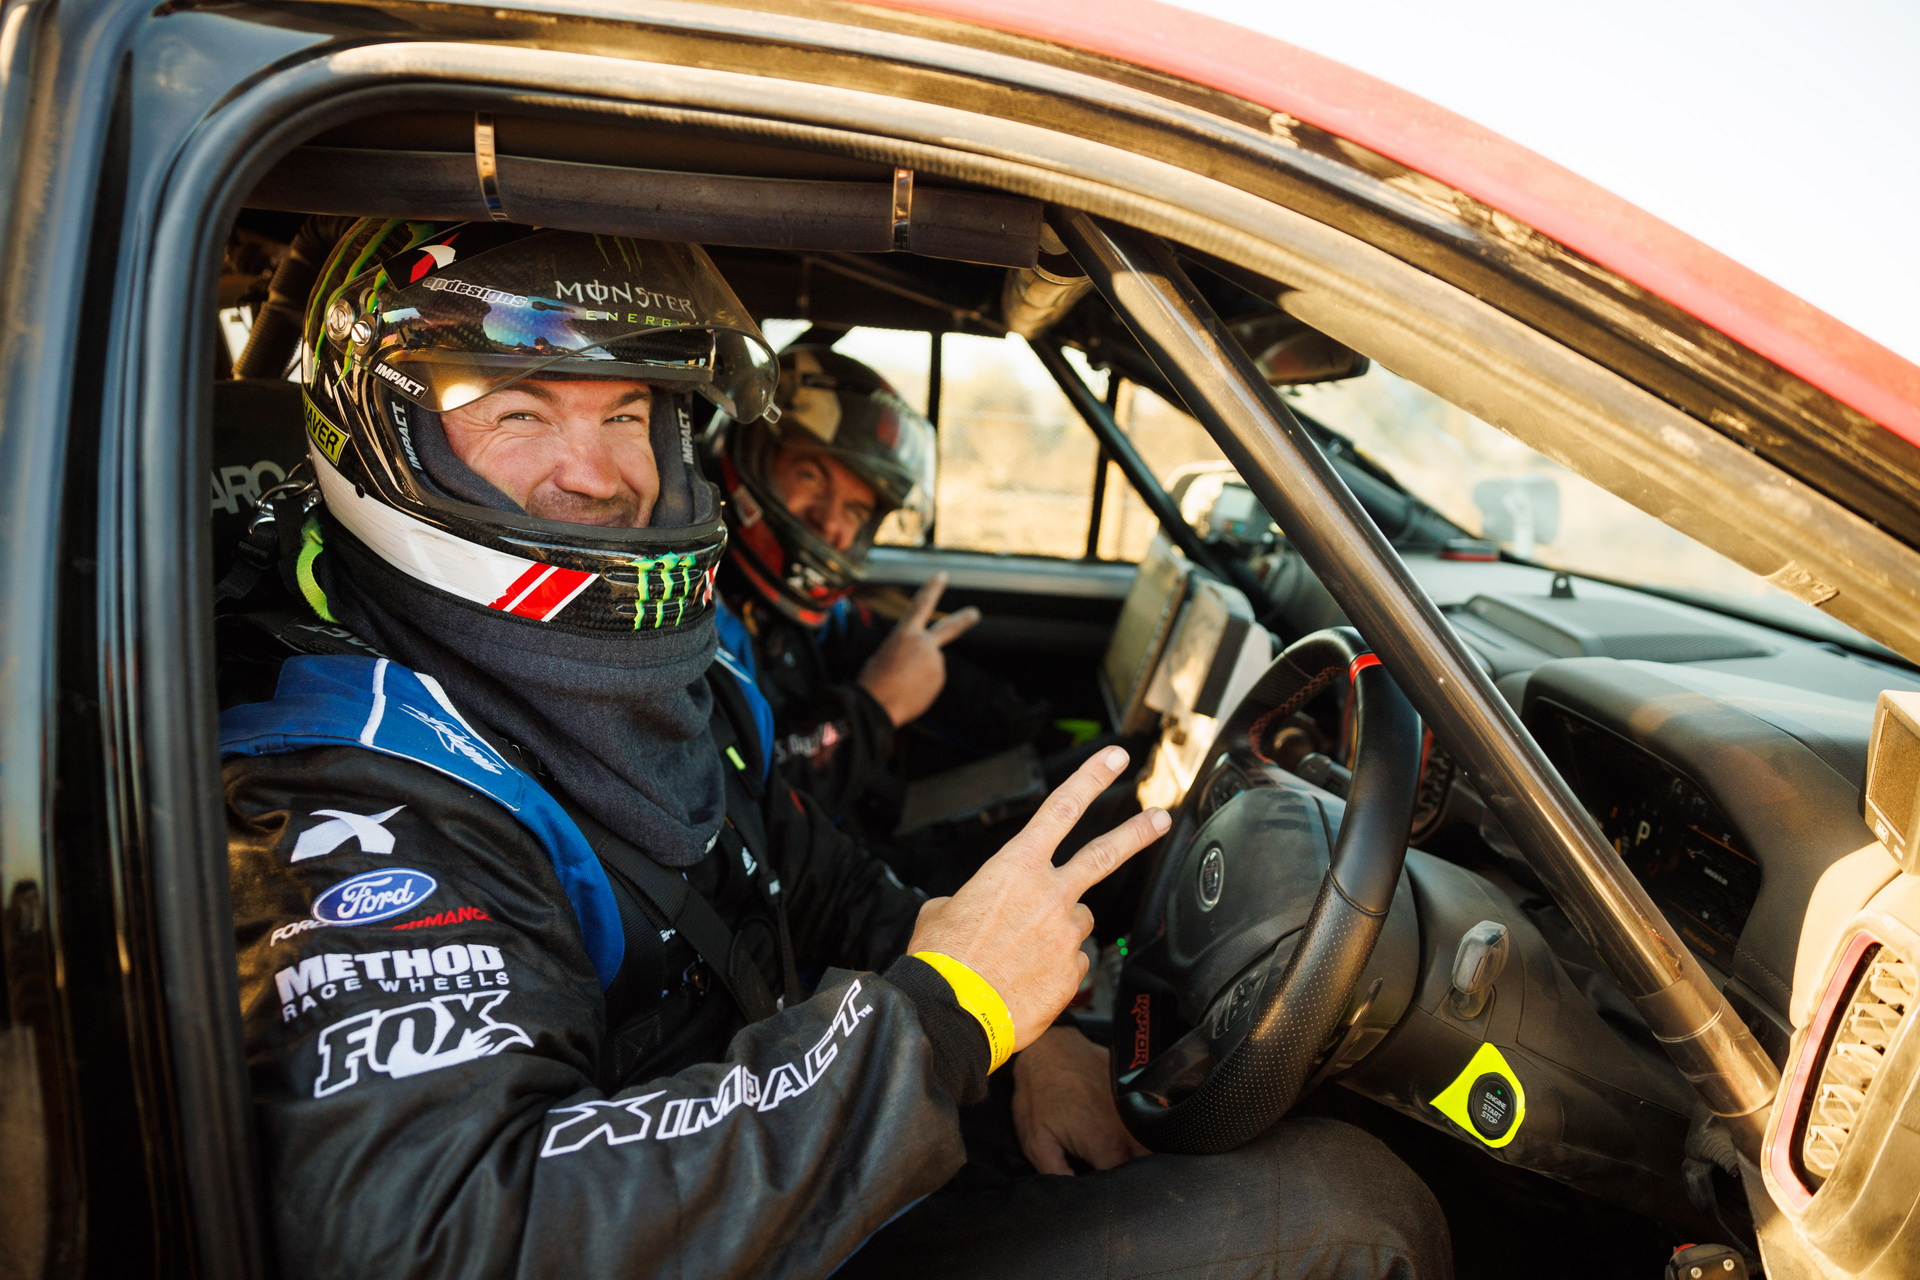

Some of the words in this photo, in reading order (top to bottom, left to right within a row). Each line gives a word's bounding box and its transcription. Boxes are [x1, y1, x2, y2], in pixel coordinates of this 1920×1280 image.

[422, 276, 529, 308] apdesigns
[554, 279, 697, 319] MONSTER
[374, 362, 426, 397] IMPACT
[391, 401, 424, 471] IMPACT
[677, 407, 695, 465] IMPACT
[1635, 820, 1651, 846] P
[336, 876, 415, 919] Ford
[274, 943, 505, 1004] METHOD
[281, 976, 363, 1023] RACE
[378, 970, 511, 993] WHEELS
[313, 989, 535, 1099] FOX
[1128, 993, 1151, 1070] RAPTOR
[1480, 1110, 1499, 1125] STOP
[1482, 1103, 1503, 1120] START
[1485, 1091, 1507, 1111] ENGINE
